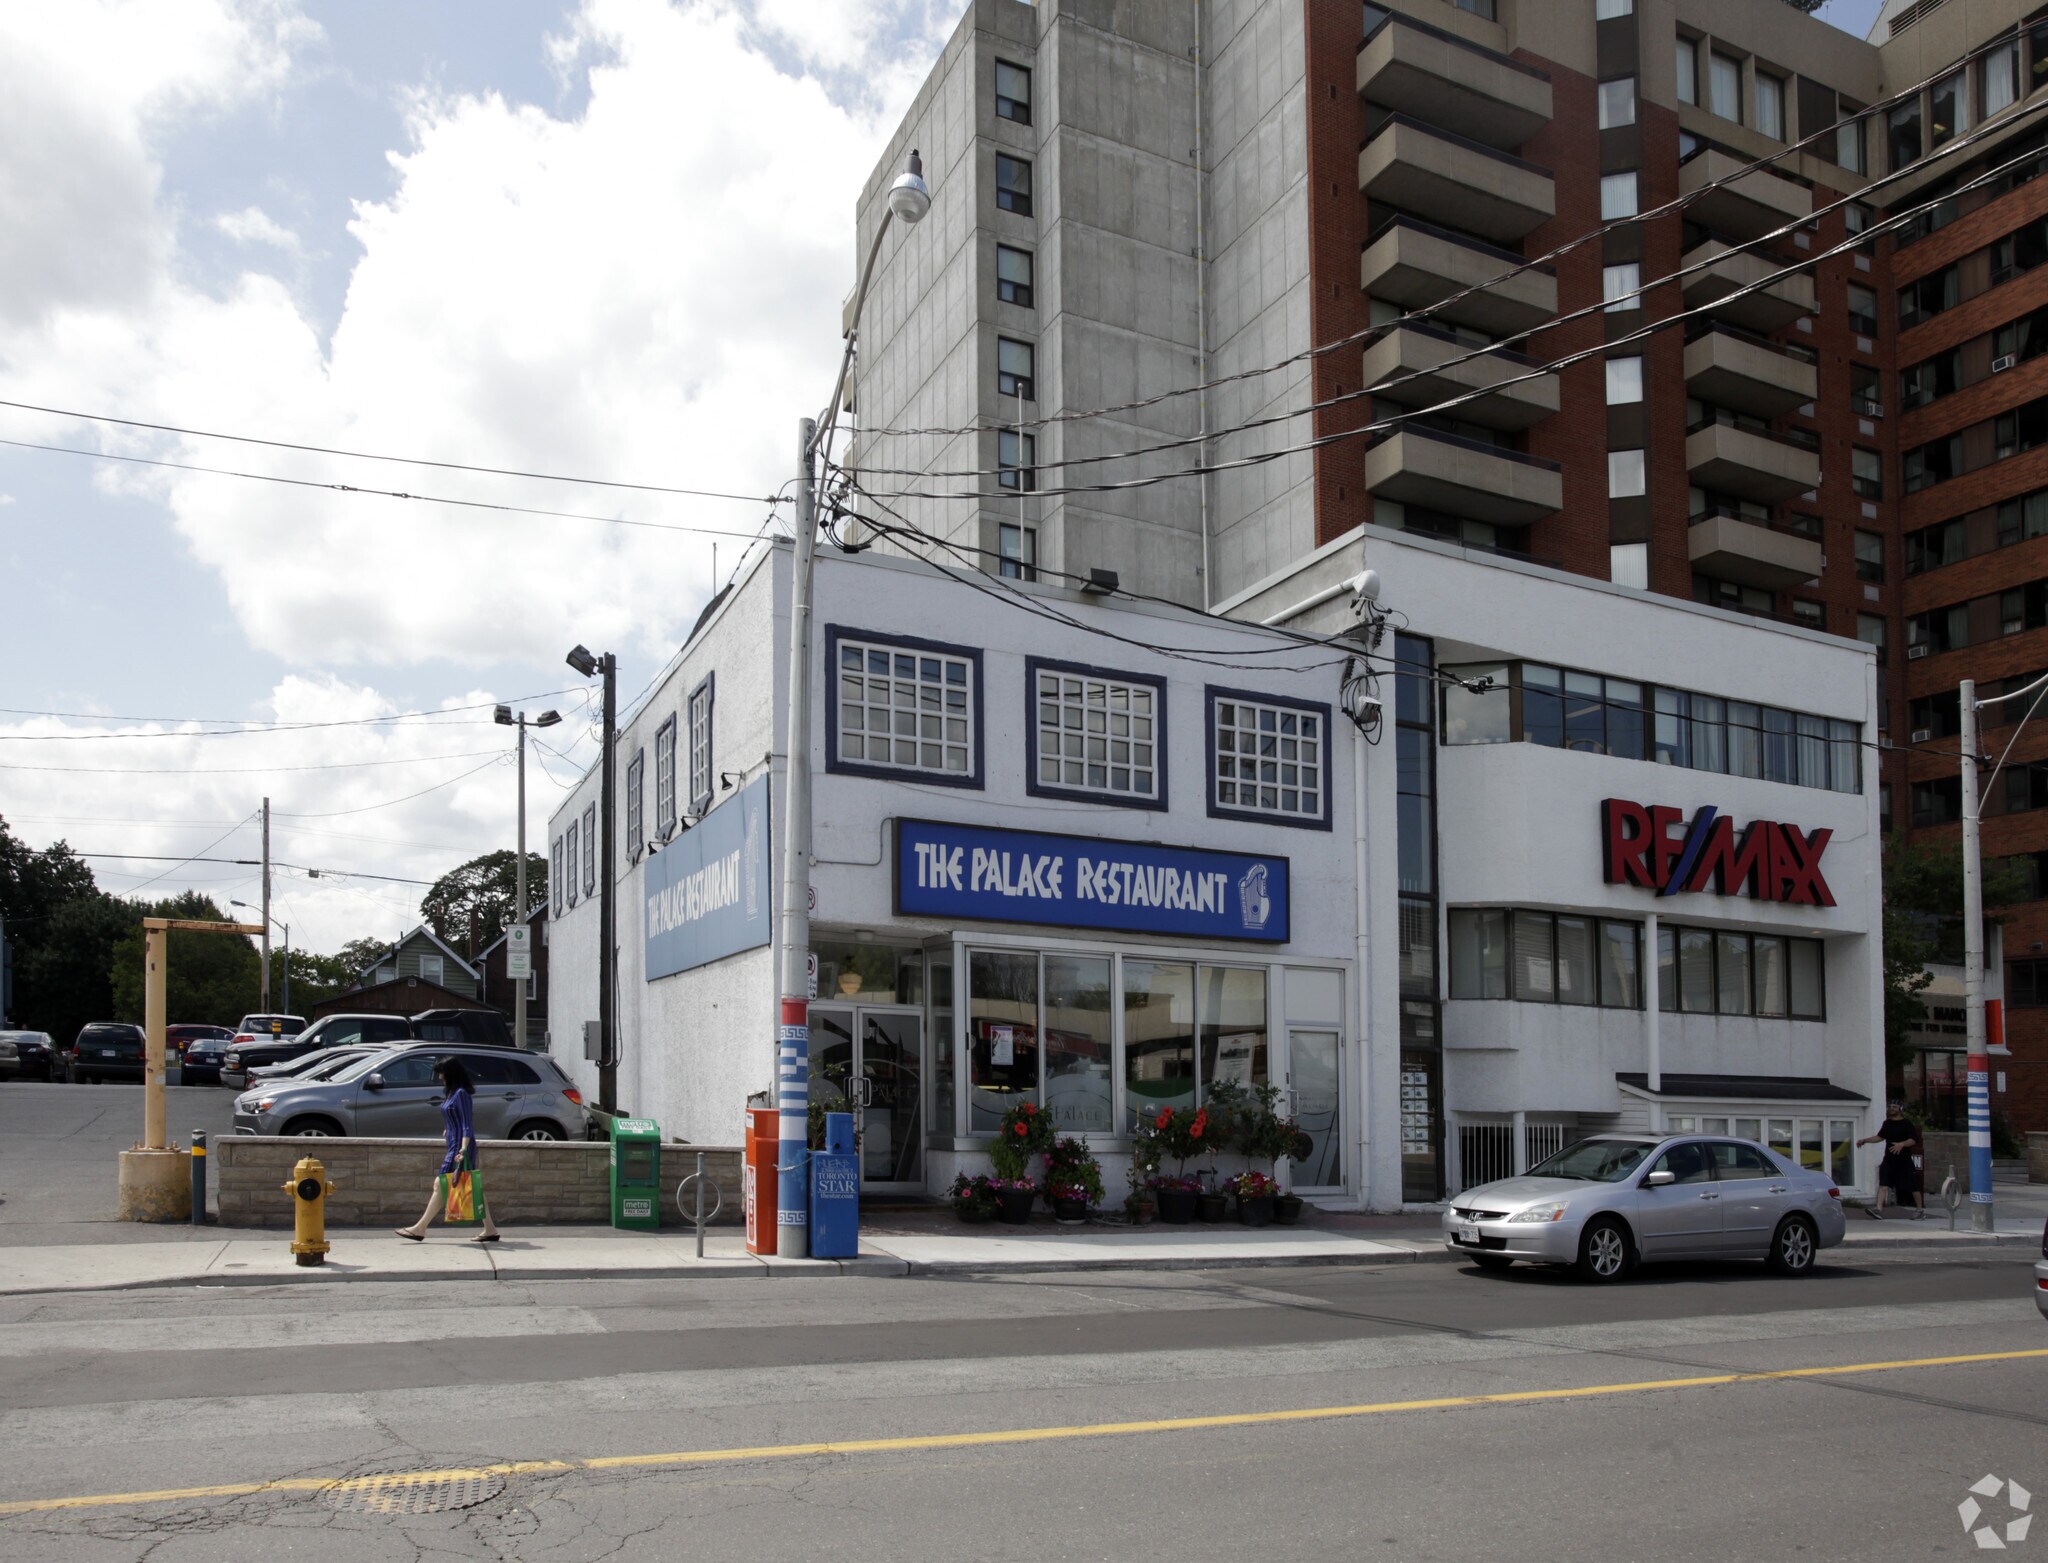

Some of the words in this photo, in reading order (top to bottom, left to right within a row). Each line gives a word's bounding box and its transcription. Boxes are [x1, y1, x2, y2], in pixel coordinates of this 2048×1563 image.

[1601, 798, 1838, 907] RE/MAX
[914, 842, 963, 891] THE
[971, 847, 1063, 899] PALACE
[1076, 857, 1228, 914] RESTAURANT
[648, 893, 660, 939] THE
[660, 878, 685, 934] PALACE
[686, 849, 740, 921] RESTAURANT
[1934, 1006, 1967, 1022] MANO
[817, 1172, 858, 1180] TORONTO
[818, 1180, 855, 1192] STAR
[625, 1201, 648, 1209] metro
